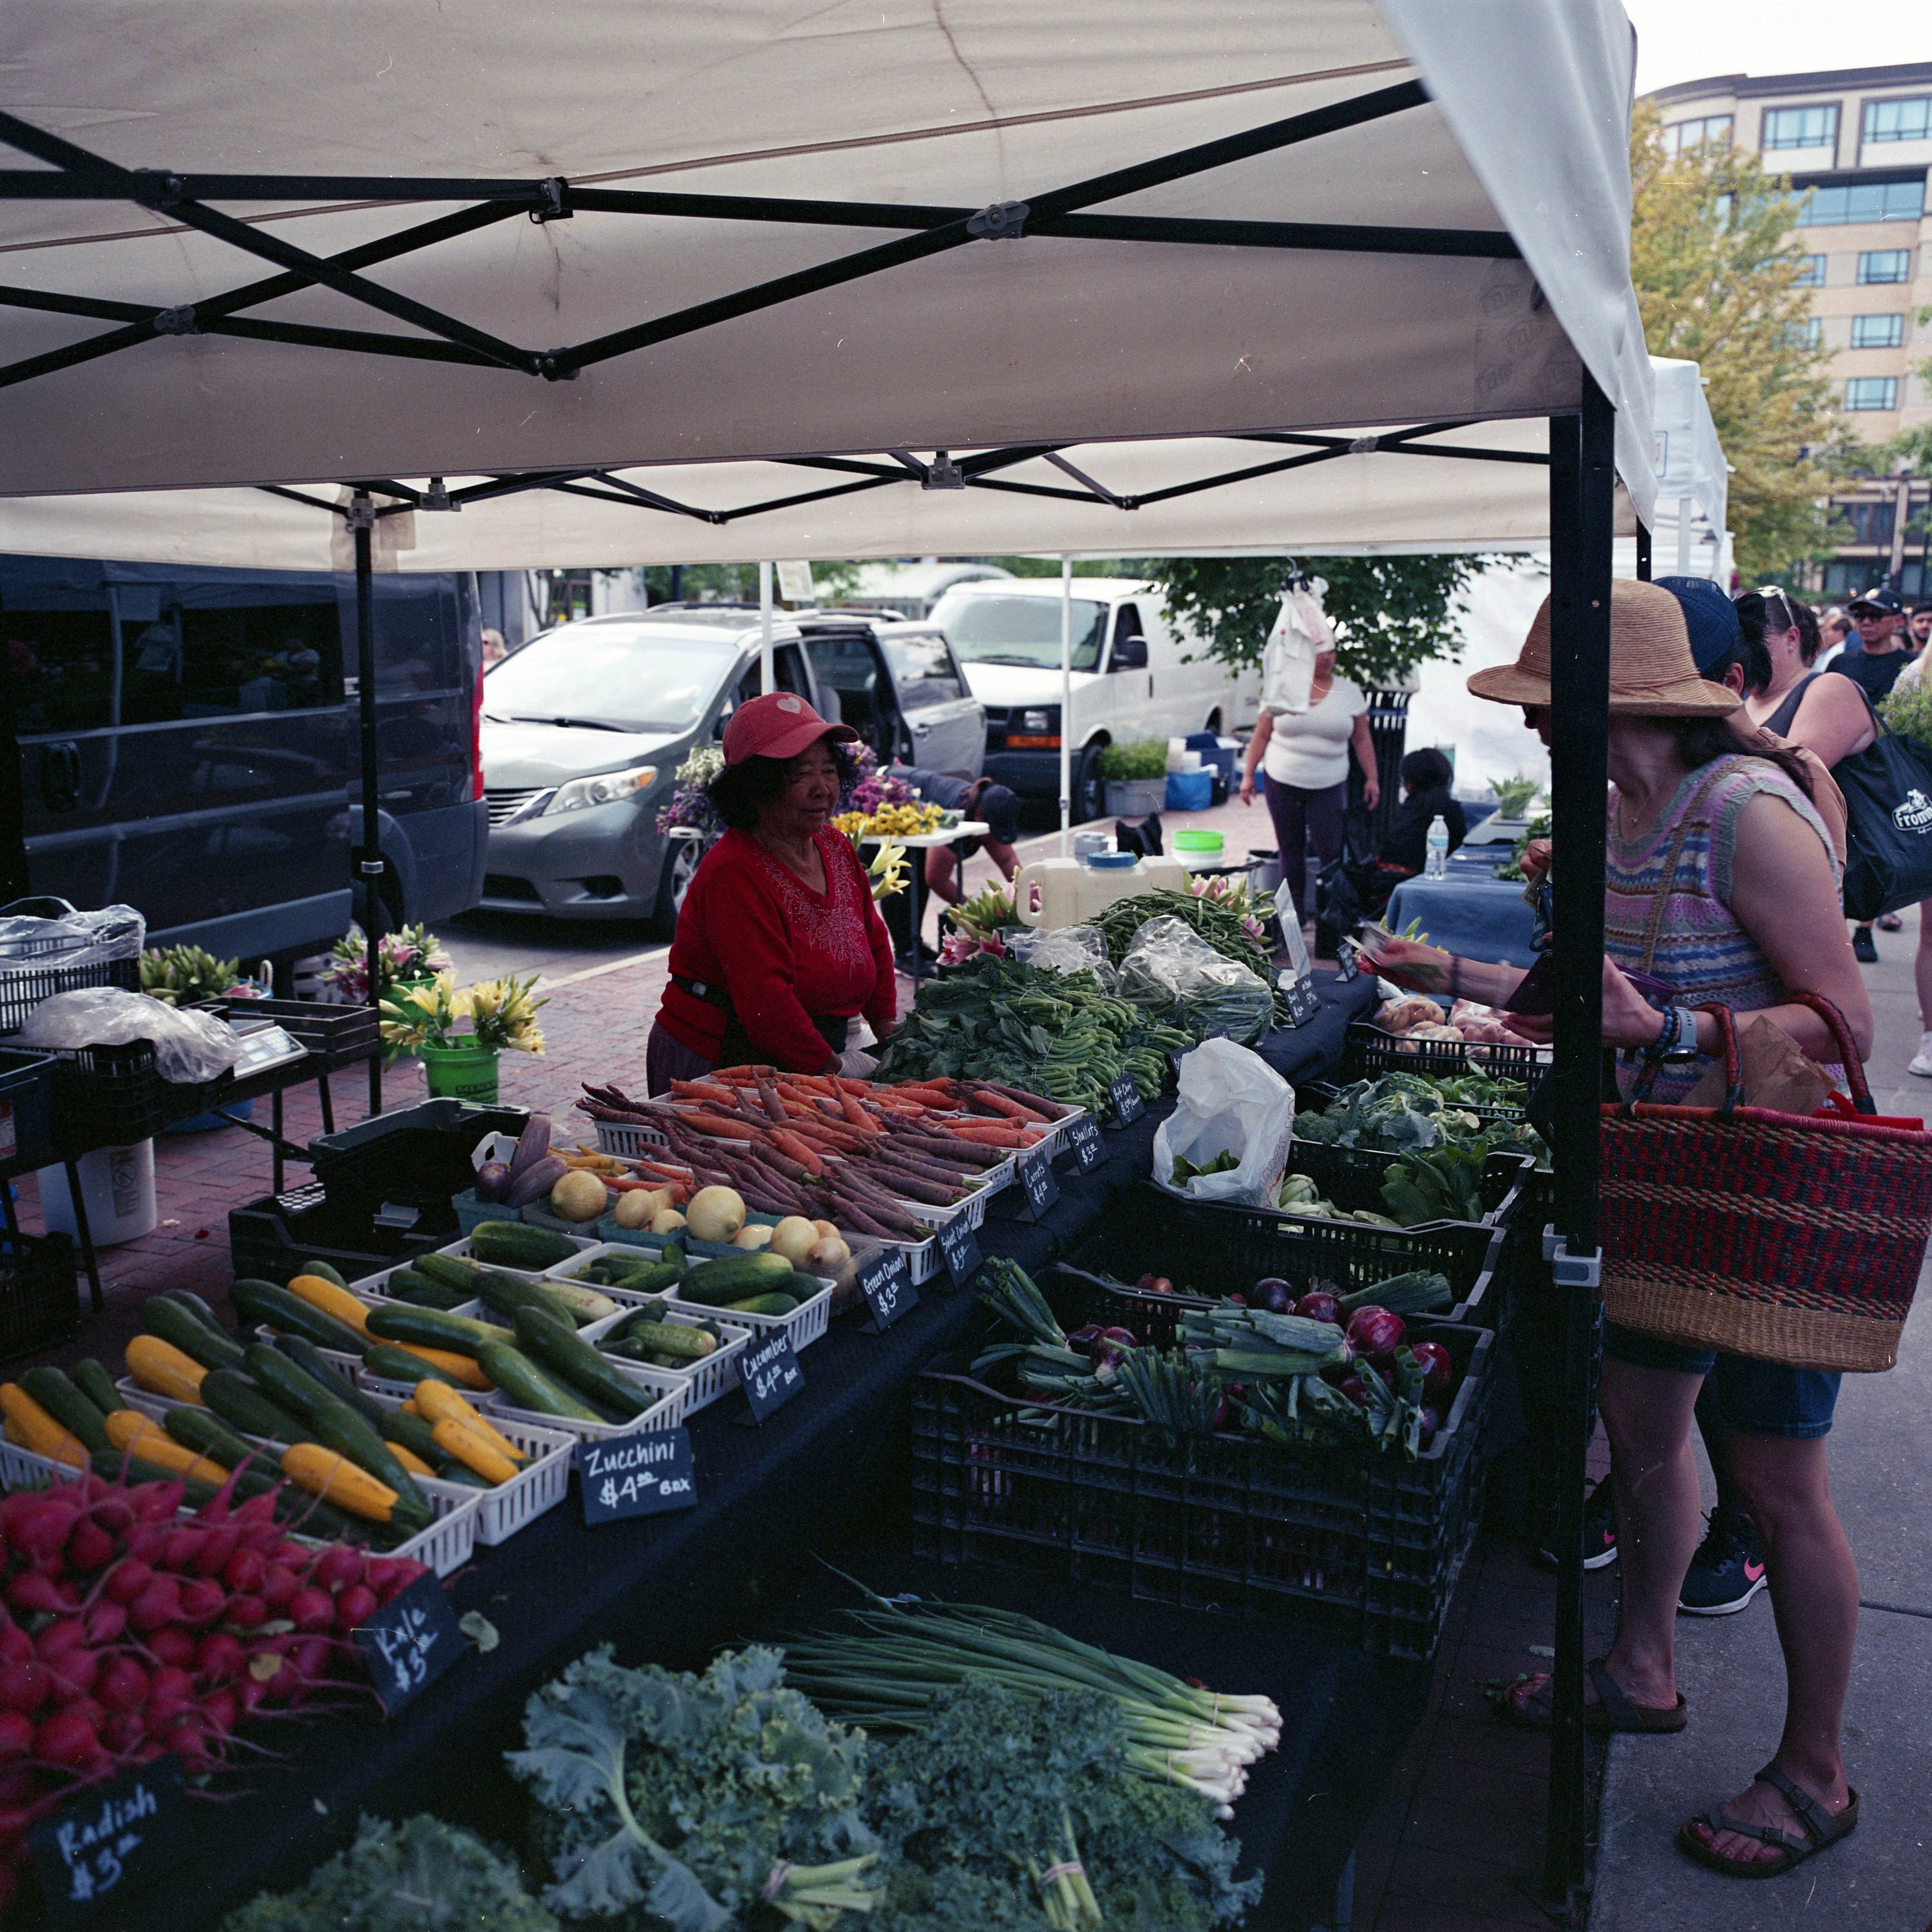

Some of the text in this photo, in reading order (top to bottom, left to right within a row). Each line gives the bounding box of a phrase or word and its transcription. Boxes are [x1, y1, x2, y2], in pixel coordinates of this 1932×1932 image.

[1072, 1122, 1098, 1146] Shallots
[863, 1256, 904, 1295] Green Onion
[743, 1334, 788, 1380] Cucumber
[584, 1435, 675, 1477] Zucchini
[375, 1607, 427, 1665] Kale
[56, 1782, 158, 1866] Radish
